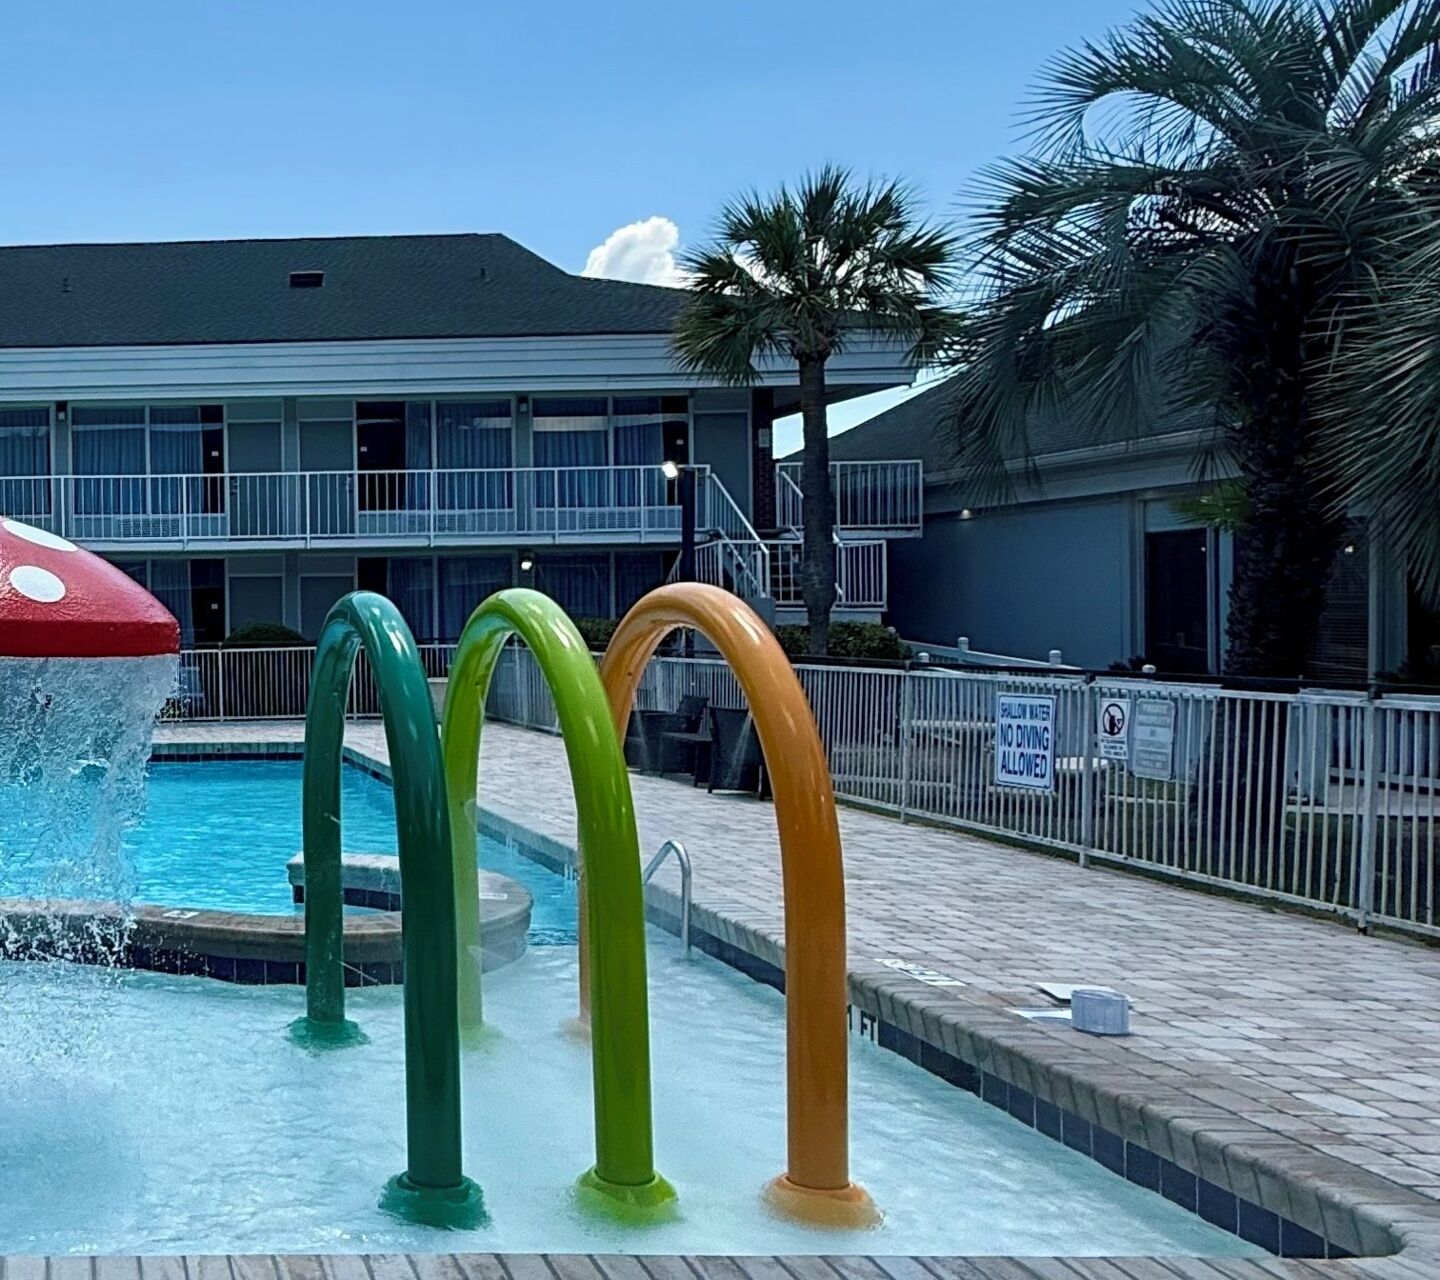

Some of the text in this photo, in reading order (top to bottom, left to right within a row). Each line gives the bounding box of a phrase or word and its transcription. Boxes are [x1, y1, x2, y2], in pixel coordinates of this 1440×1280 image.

[1000, 702, 1051, 721] SHALLOW WATER
[1000, 723, 1050, 751] NO DIVING
[1000, 751, 1047, 779] ALLOWED
[860, 1010, 877, 1042] FT
